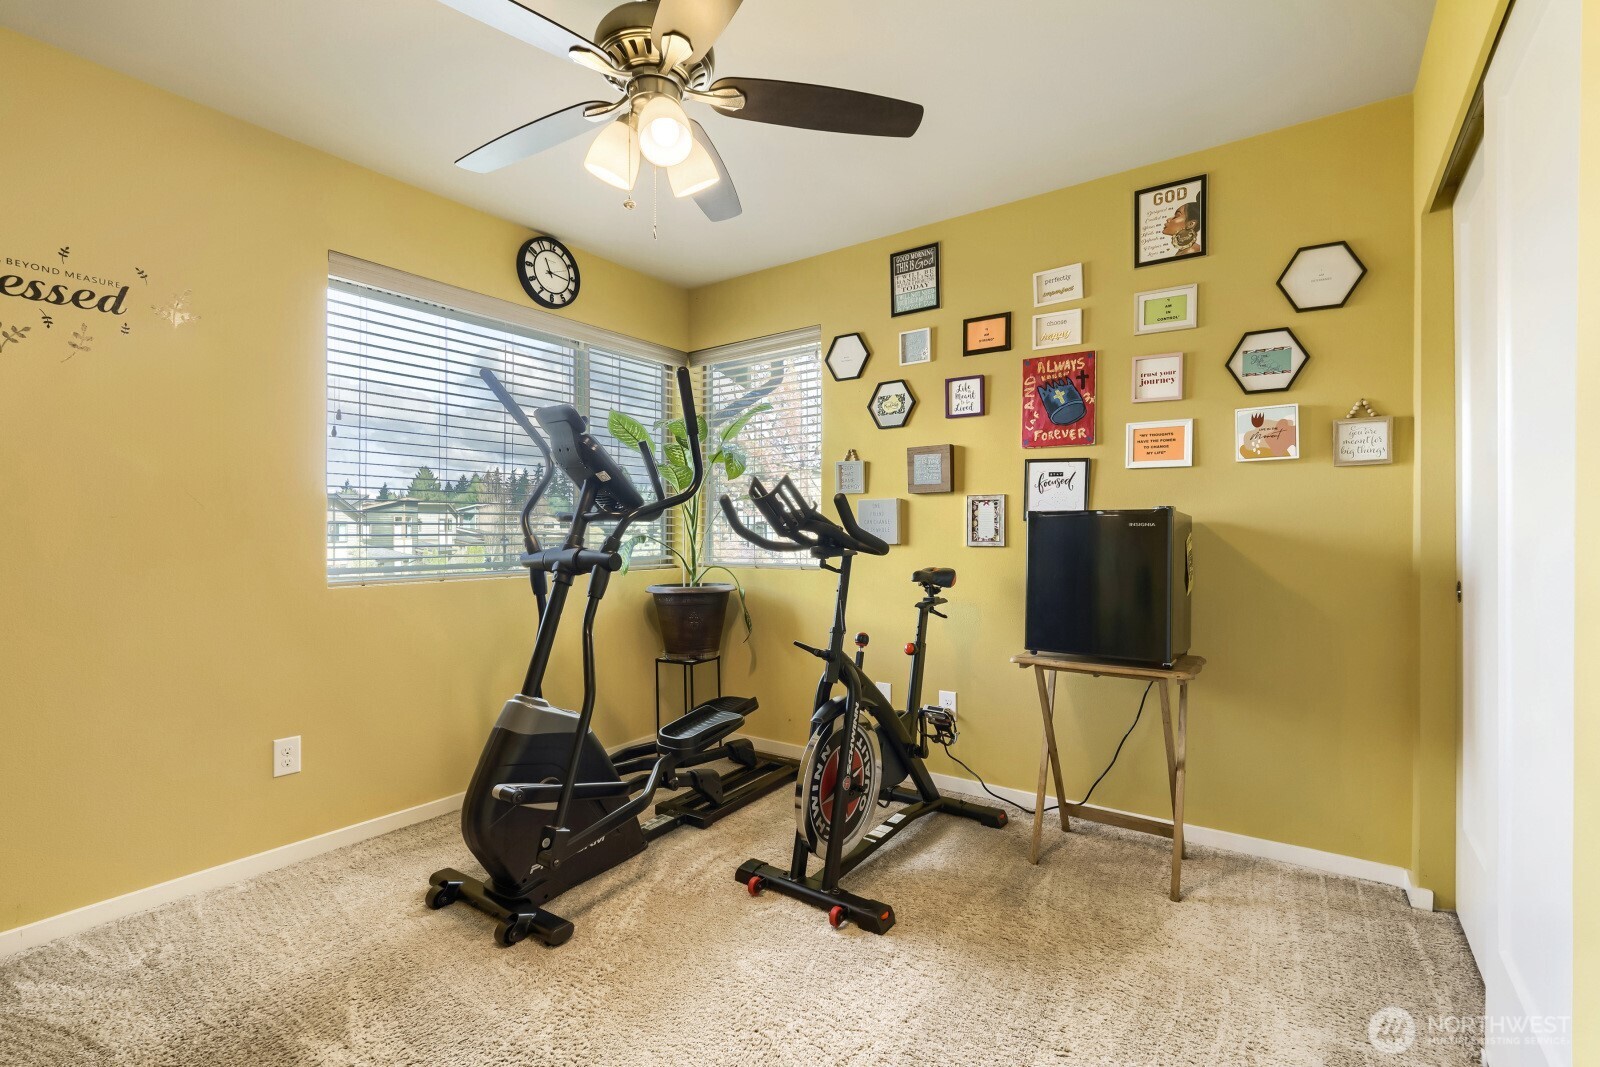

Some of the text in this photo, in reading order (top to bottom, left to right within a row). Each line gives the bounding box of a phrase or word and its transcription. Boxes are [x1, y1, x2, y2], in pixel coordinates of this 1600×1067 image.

[1153, 186, 1188, 206] GOD
[896, 248, 935, 263] GOOD MORNING
[896, 253, 934, 274] THIS IS God
[6, 257, 120, 289] BEYOND MEASURE
[1044, 274, 1071, 286] perfectly
[902, 281, 929, 292] TODAY
[1046, 319, 1068, 327] choose
[1040, 330, 1071, 342] happy
[1037, 356, 1085, 374] ALWAYS
[956, 382, 971, 393] Life
[1139, 377, 1175, 387] journey
[955, 390, 976, 400] Meant
[954, 404, 974, 412] Lived
[1033, 427, 1087, 441] FOREVER
[1342, 435, 1382, 446] meant for
[1340, 445, 1386, 459] big things
[1034, 471, 1076, 494] focused
[846, 701, 860, 775] SCHWINN
[856, 737, 871, 812] QUALIT
